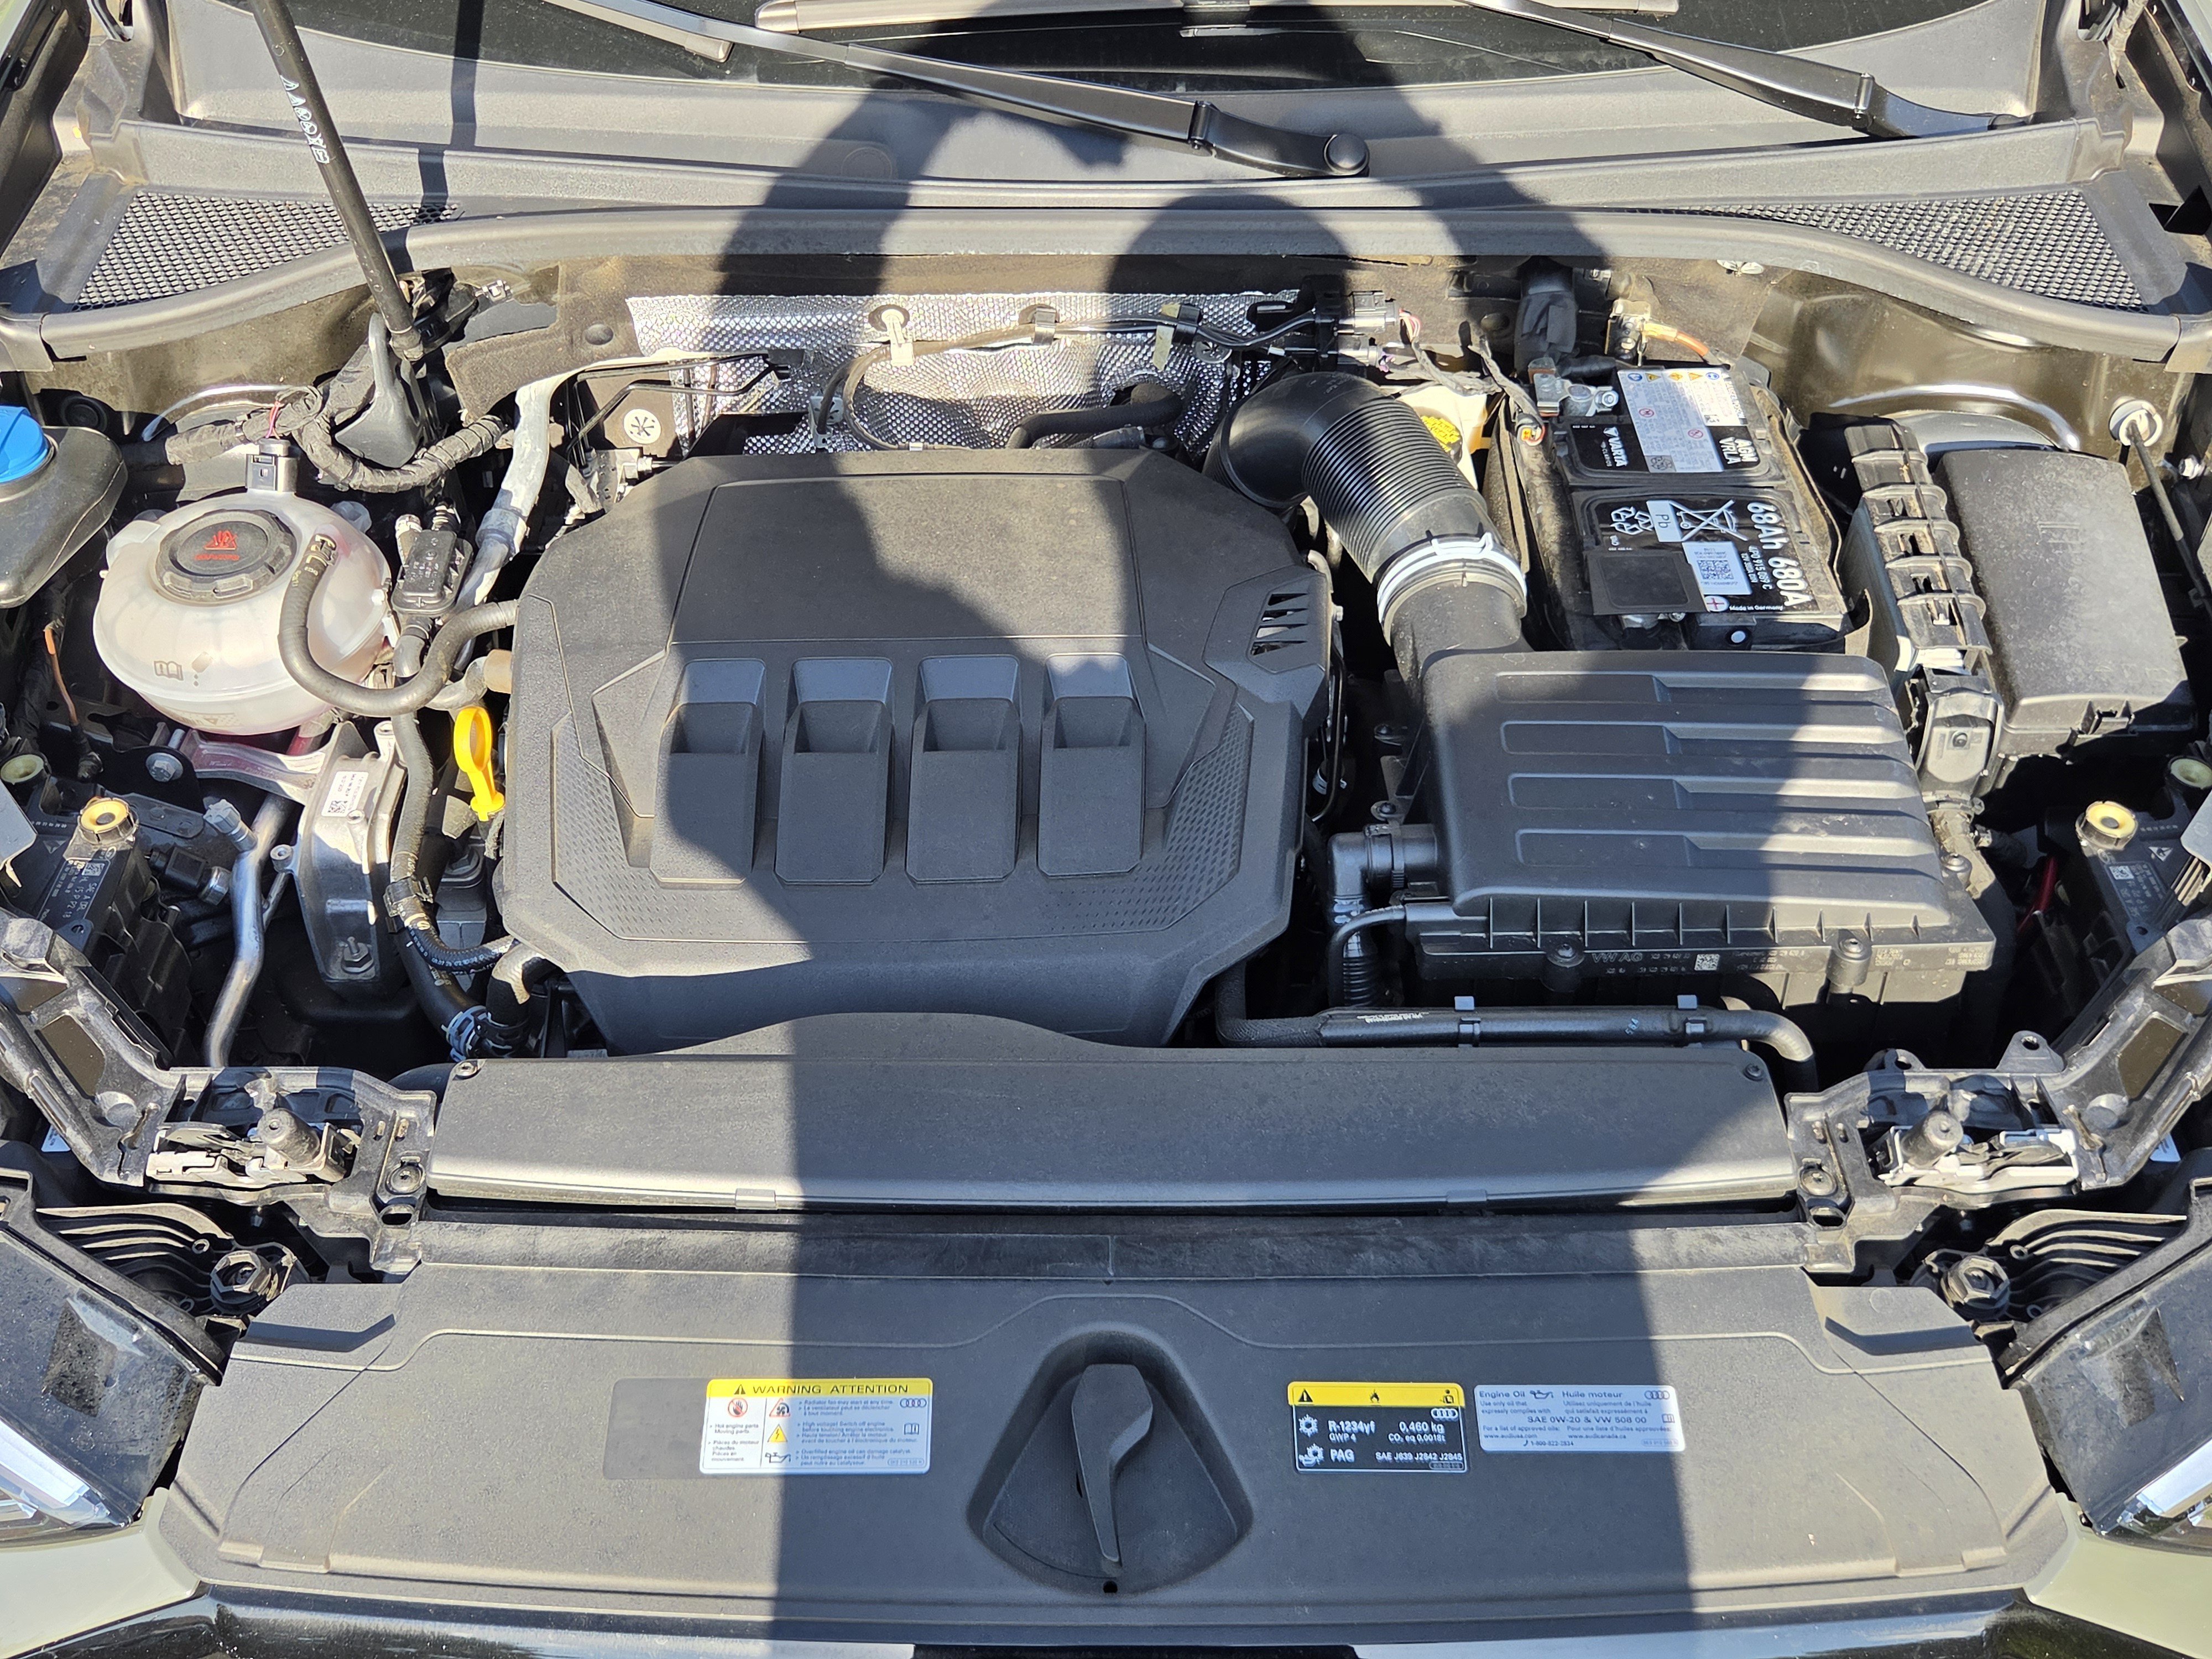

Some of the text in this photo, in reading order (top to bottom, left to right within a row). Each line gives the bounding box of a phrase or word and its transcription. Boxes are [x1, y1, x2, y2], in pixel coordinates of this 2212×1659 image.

[1608, 437, 1629, 467] VARTA
[1719, 437, 1741, 464] VRLA
[1734, 439, 1759, 462] AGM
[1656, 514, 1671, 528] Pb
[1747, 502, 1813, 606] 68Ah 680A
[1753, 559, 1765, 571] 915
[1592, 953, 1618, 963] VW
[1618, 952, 1643, 962] AG
[753, 1385, 908, 1394] WARNING ATTENTION
[1479, 1390, 1510, 1399] Engine
[1328, 1420, 1375, 1435] R-1234yf
[1431, 1421, 1445, 1434] kg
[1328, 1433, 1349, 1442] GWP
[1350, 1433, 1357, 1442] 4
[1405, 1434, 1416, 1444] eq
[1330, 1448, 1463, 1462] PAG SAE J639 J2842 J2845
